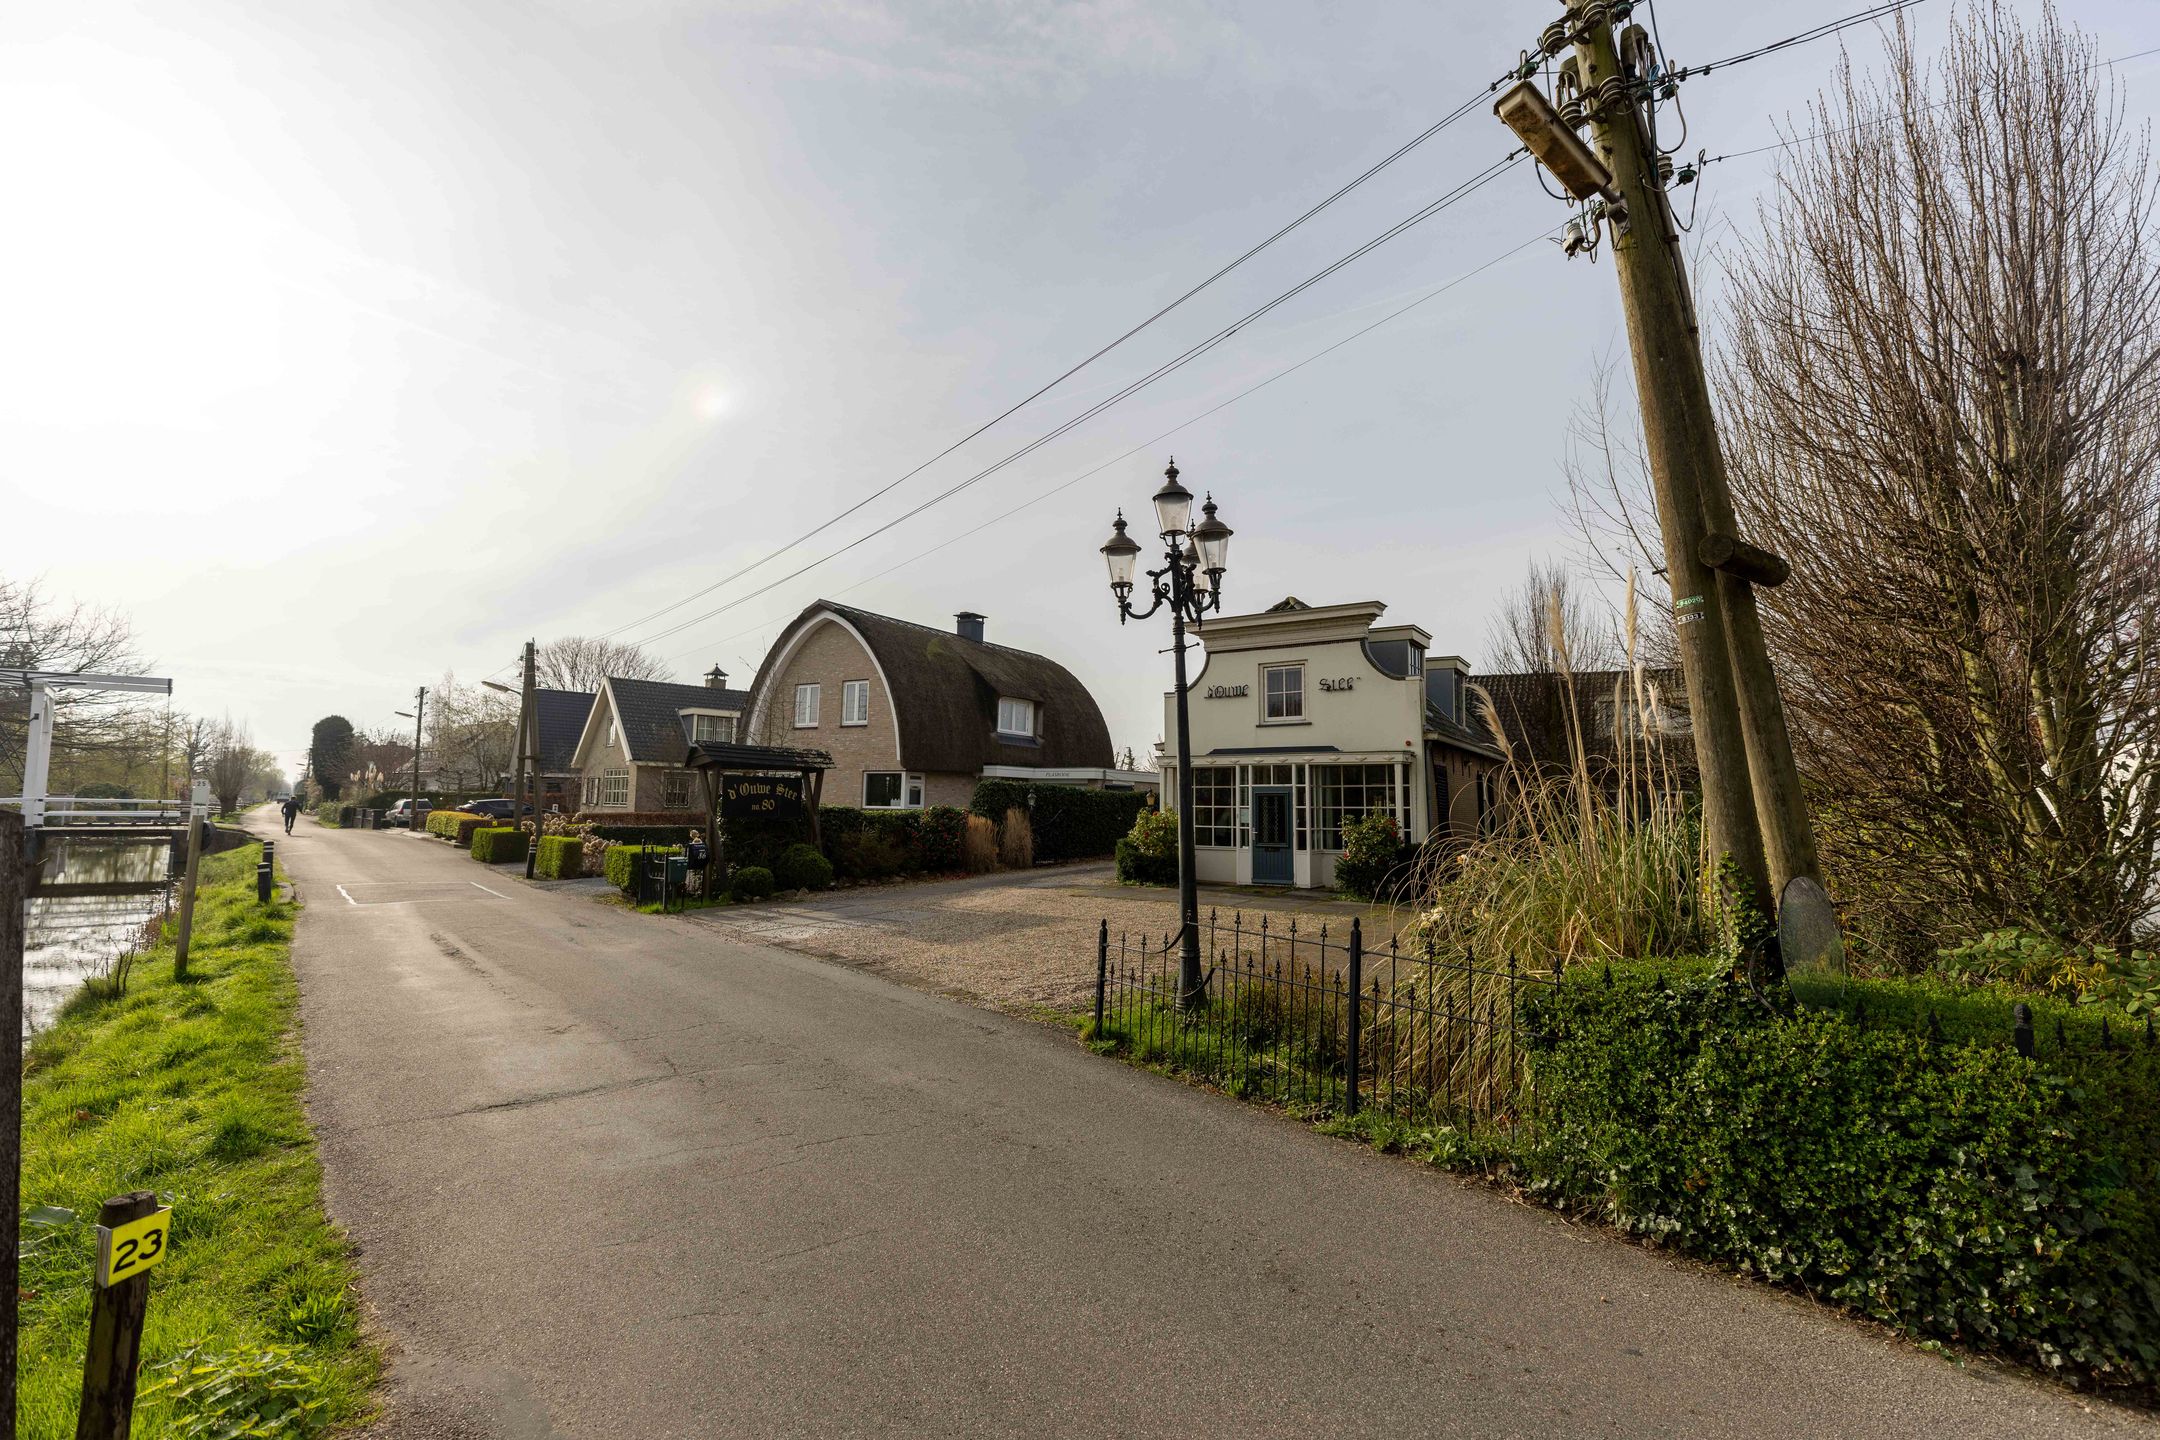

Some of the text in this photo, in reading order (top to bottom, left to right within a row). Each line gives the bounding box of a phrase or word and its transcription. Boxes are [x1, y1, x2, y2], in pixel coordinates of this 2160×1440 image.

[728, 782, 798, 801] d'Ouwe Stee
[761, 800, 775, 811] 80
[113, 1228, 163, 1274] 23
